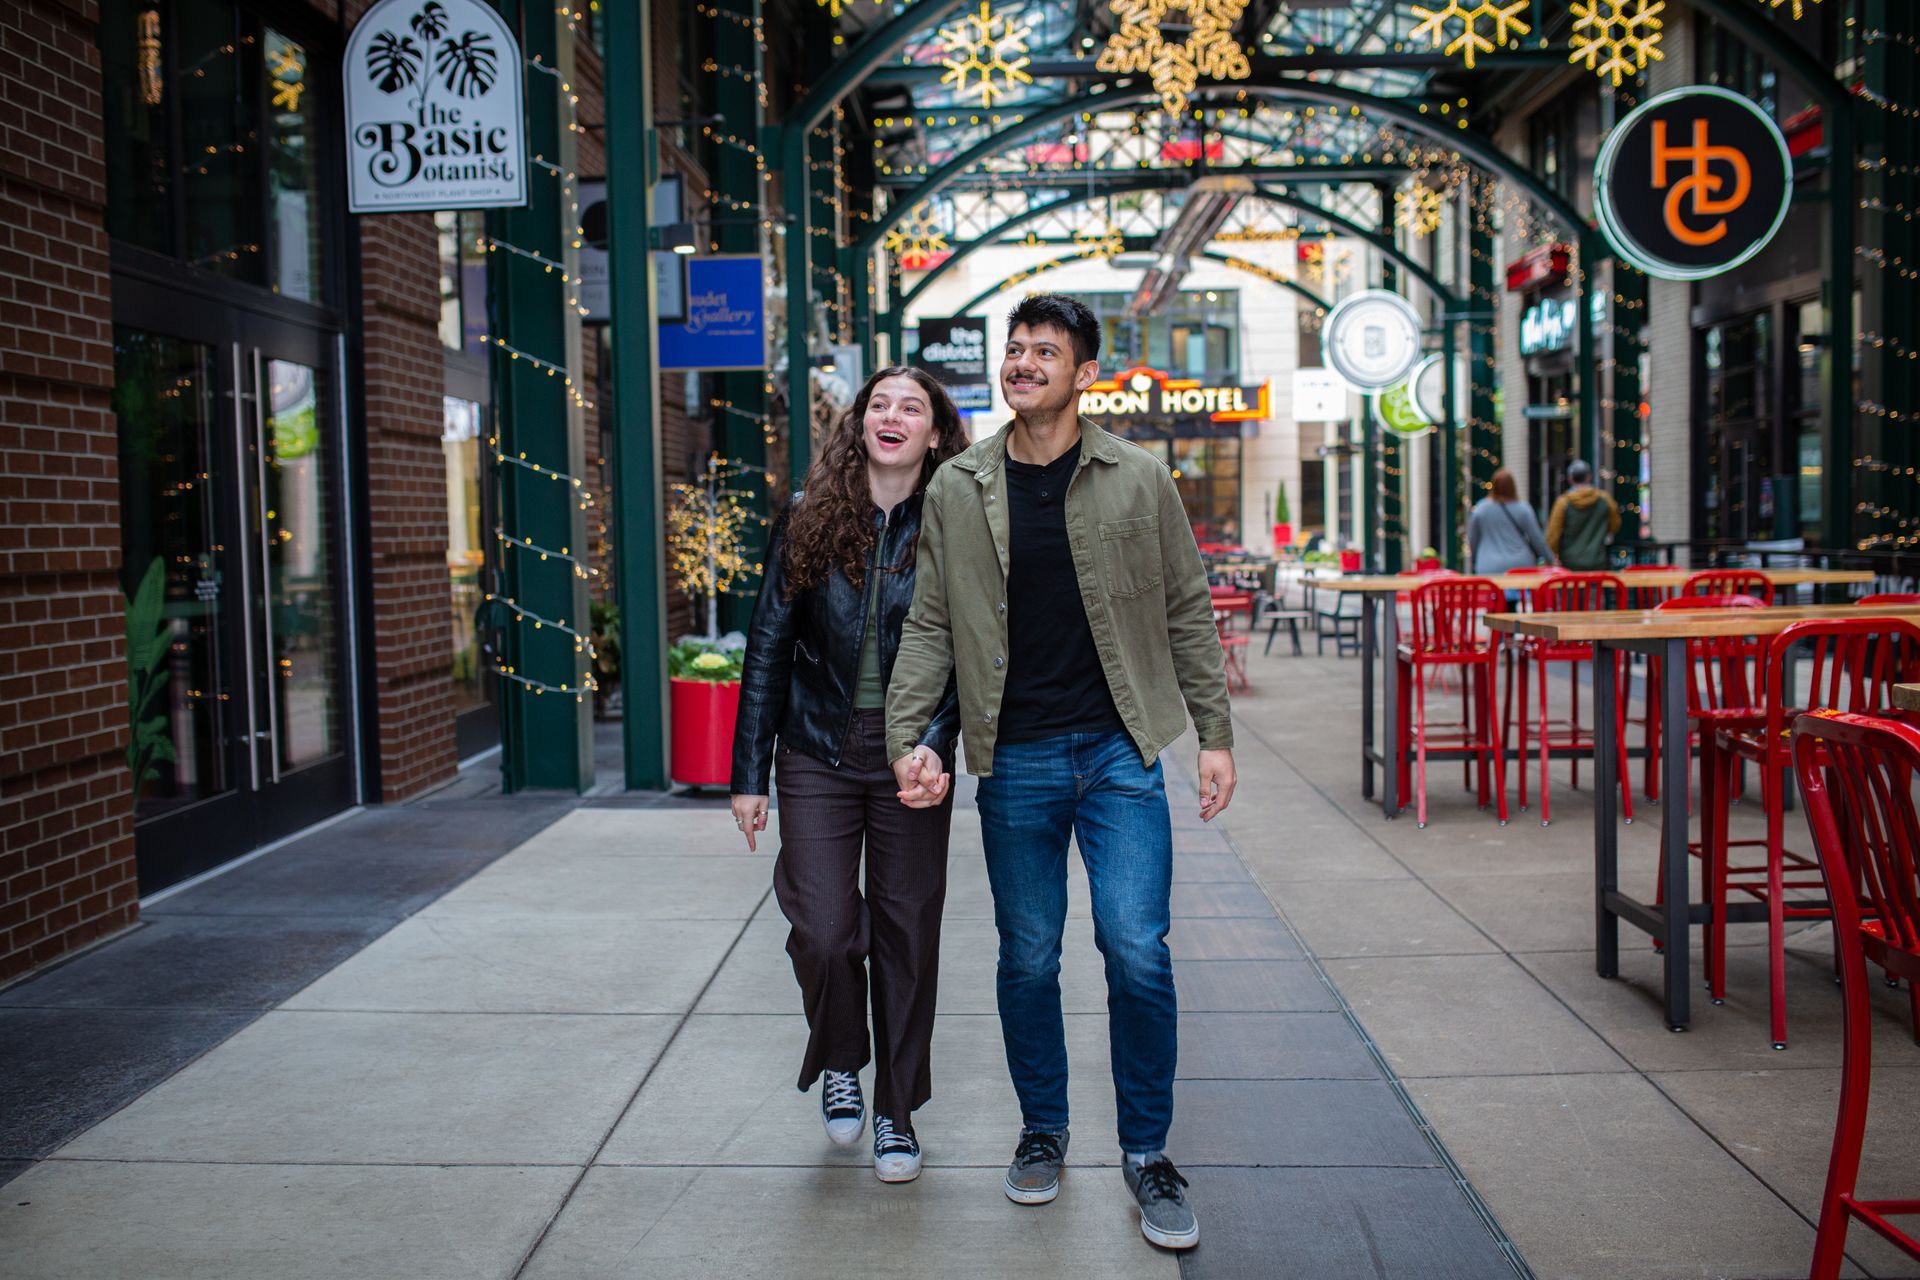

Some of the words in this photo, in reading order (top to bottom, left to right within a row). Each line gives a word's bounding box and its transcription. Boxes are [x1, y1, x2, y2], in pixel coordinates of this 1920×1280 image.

[409, 99, 461, 127] the
[355, 121, 508, 188] Basic
[438, 188, 467, 199] PLANT
[469, 187, 493, 197] SHOP
[950, 326, 984, 344] the
[922, 342, 985, 362] district
[1161, 388, 1249, 413] HOTEL
